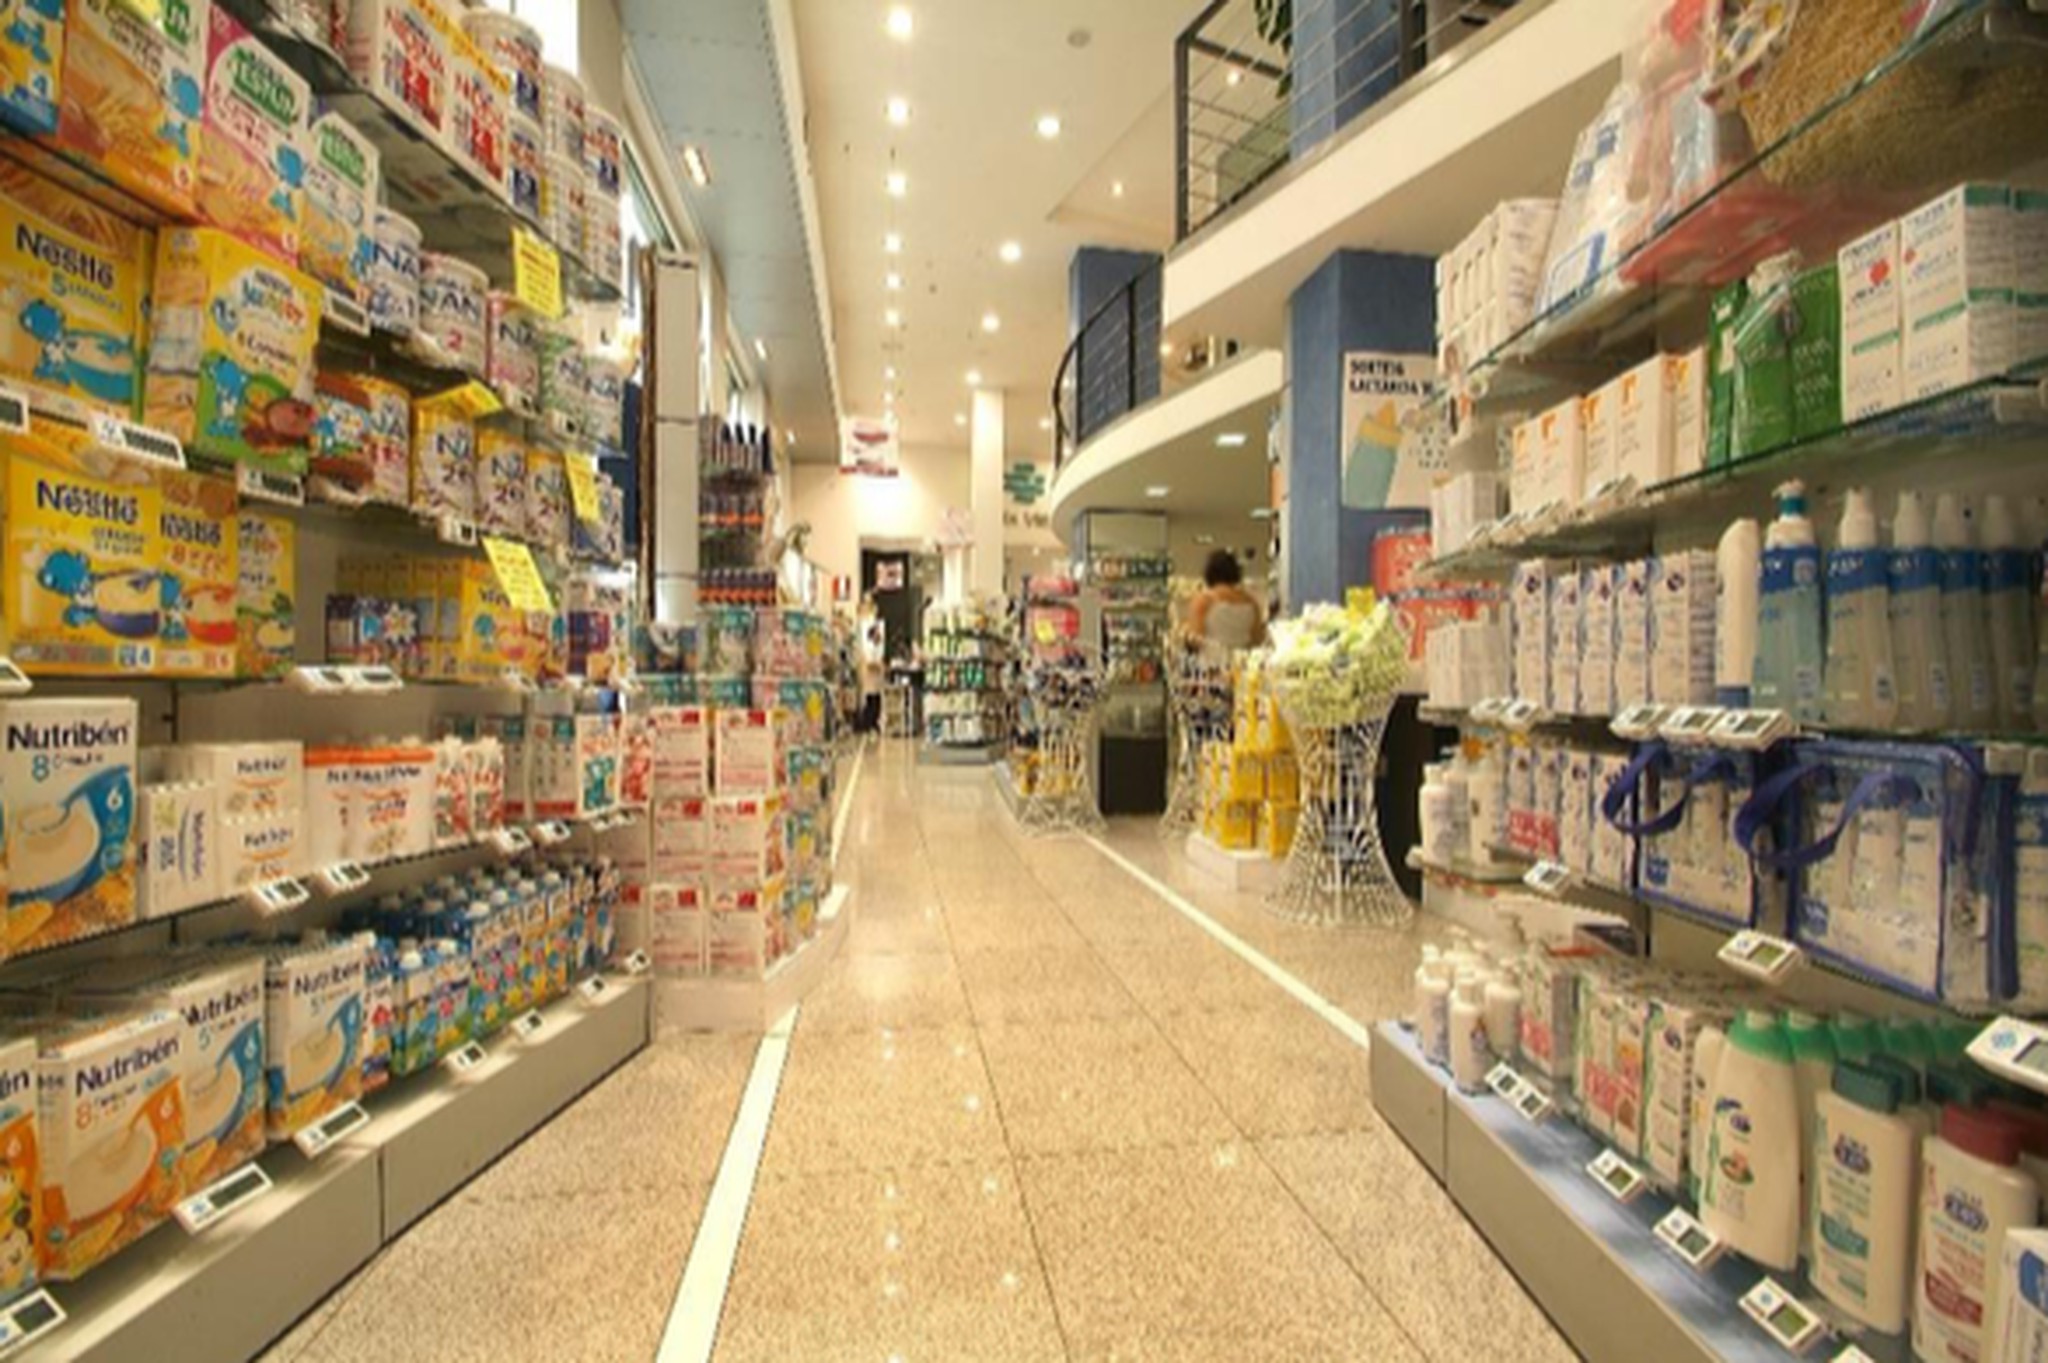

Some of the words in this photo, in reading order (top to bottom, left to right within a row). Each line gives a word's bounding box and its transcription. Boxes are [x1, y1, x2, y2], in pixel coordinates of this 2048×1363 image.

[15, 222, 115, 291] Nestlé
[36, 479, 139, 526] Nestlé
[8, 721, 129, 752] Nutribén
[32, 754, 49, 782] 8
[75, 1032, 181, 1097] Nutribén
[75, 1101, 93, 1131] 8
